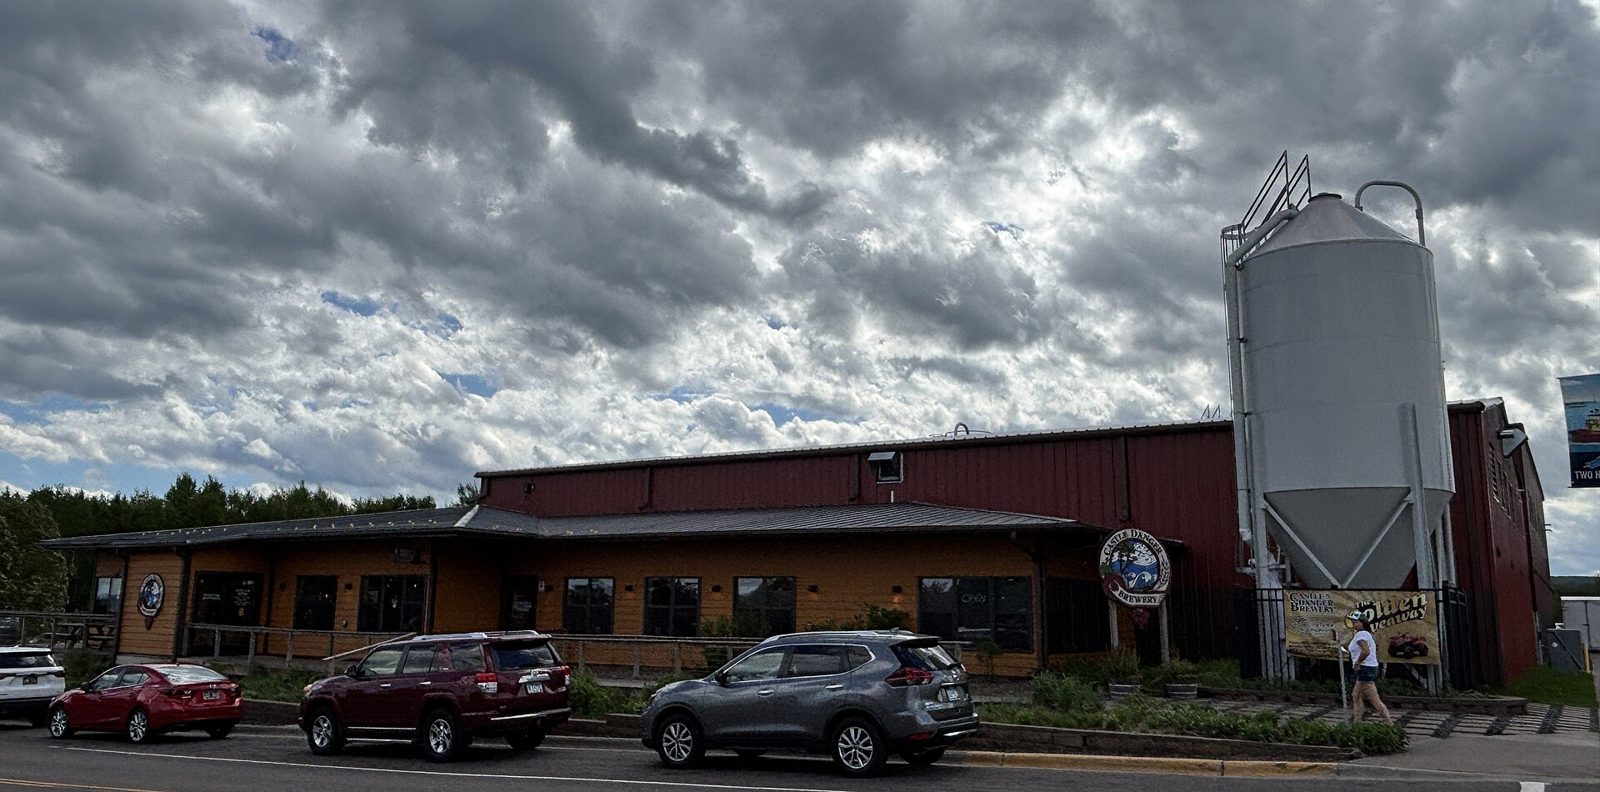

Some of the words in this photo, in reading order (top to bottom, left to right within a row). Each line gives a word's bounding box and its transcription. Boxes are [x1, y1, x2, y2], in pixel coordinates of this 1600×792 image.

[1574, 470, 1593, 480] TWO
[1103, 530, 1128, 556] CASTLE
[1131, 530, 1163, 554] DANGER
[1118, 590, 1158, 603] BREWERY
[1290, 602, 1335, 613] BREWERY
[1362, 593, 1428, 622] olden
